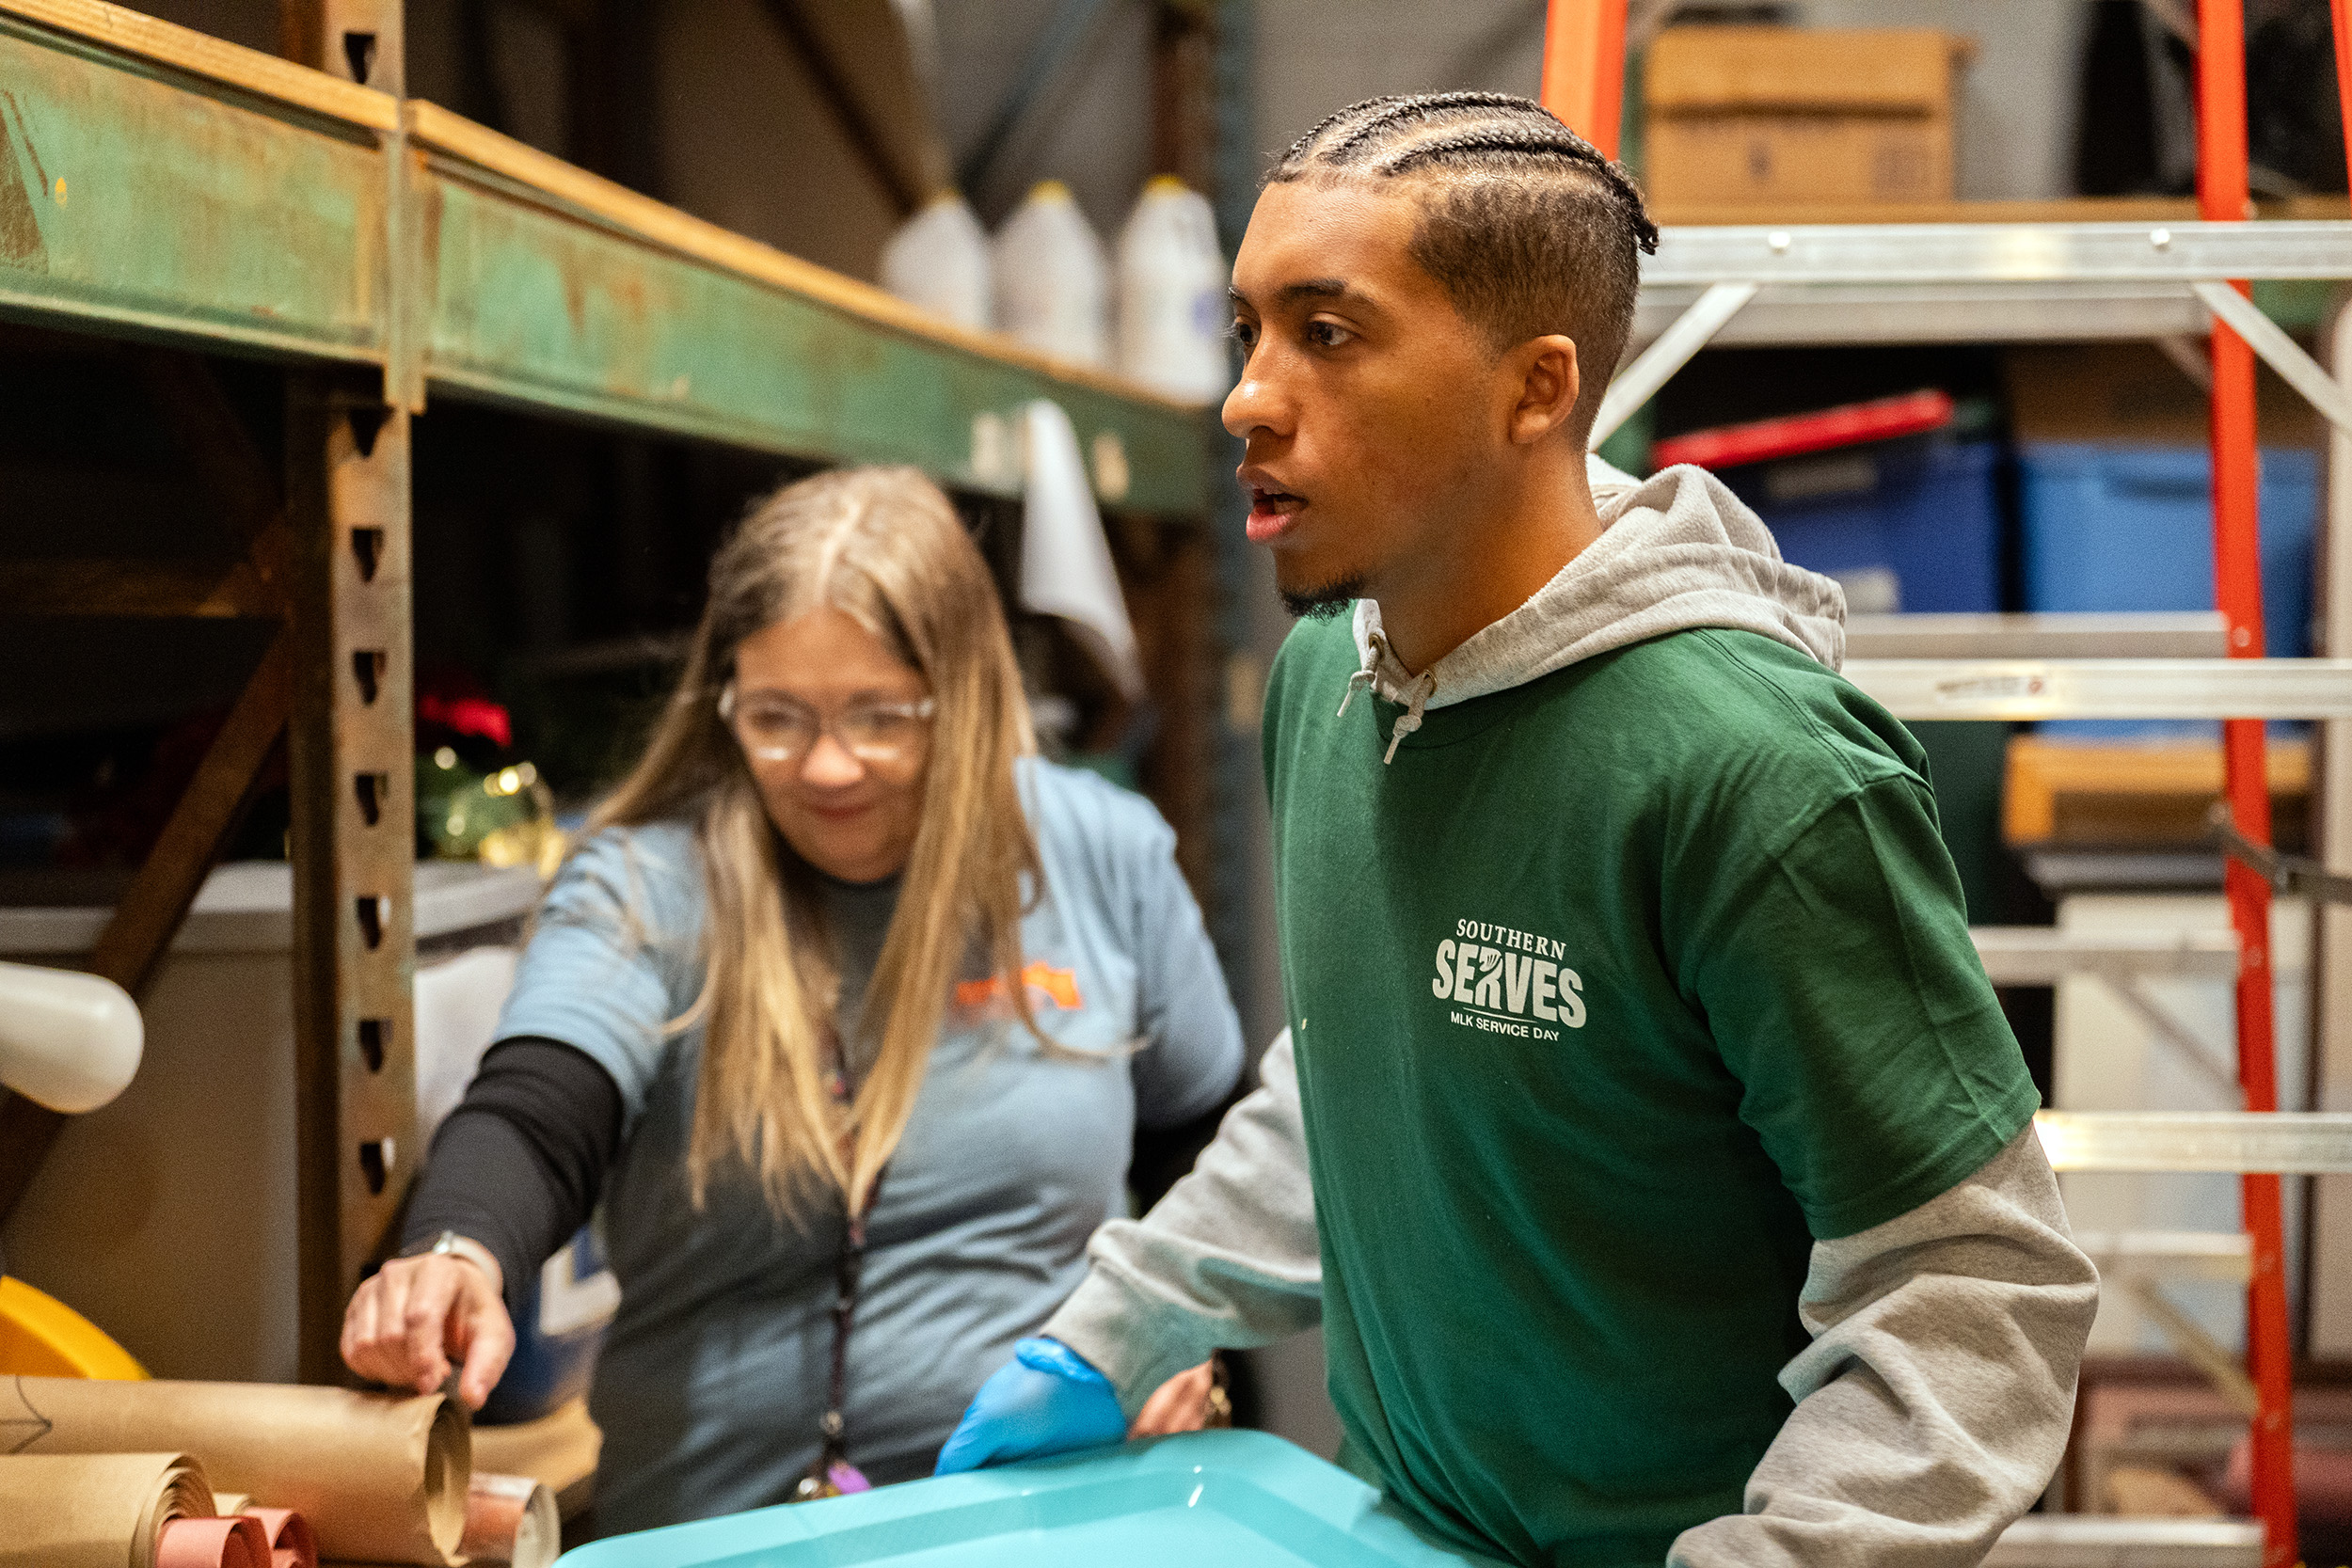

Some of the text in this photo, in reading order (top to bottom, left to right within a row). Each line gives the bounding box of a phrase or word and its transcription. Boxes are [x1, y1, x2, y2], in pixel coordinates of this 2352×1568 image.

[1456, 918, 1566, 960] SOUTHERN
[1432, 939, 1587, 1029] SERVES
[1451, 1011, 1560, 1041] MLK SERVICE DAY
